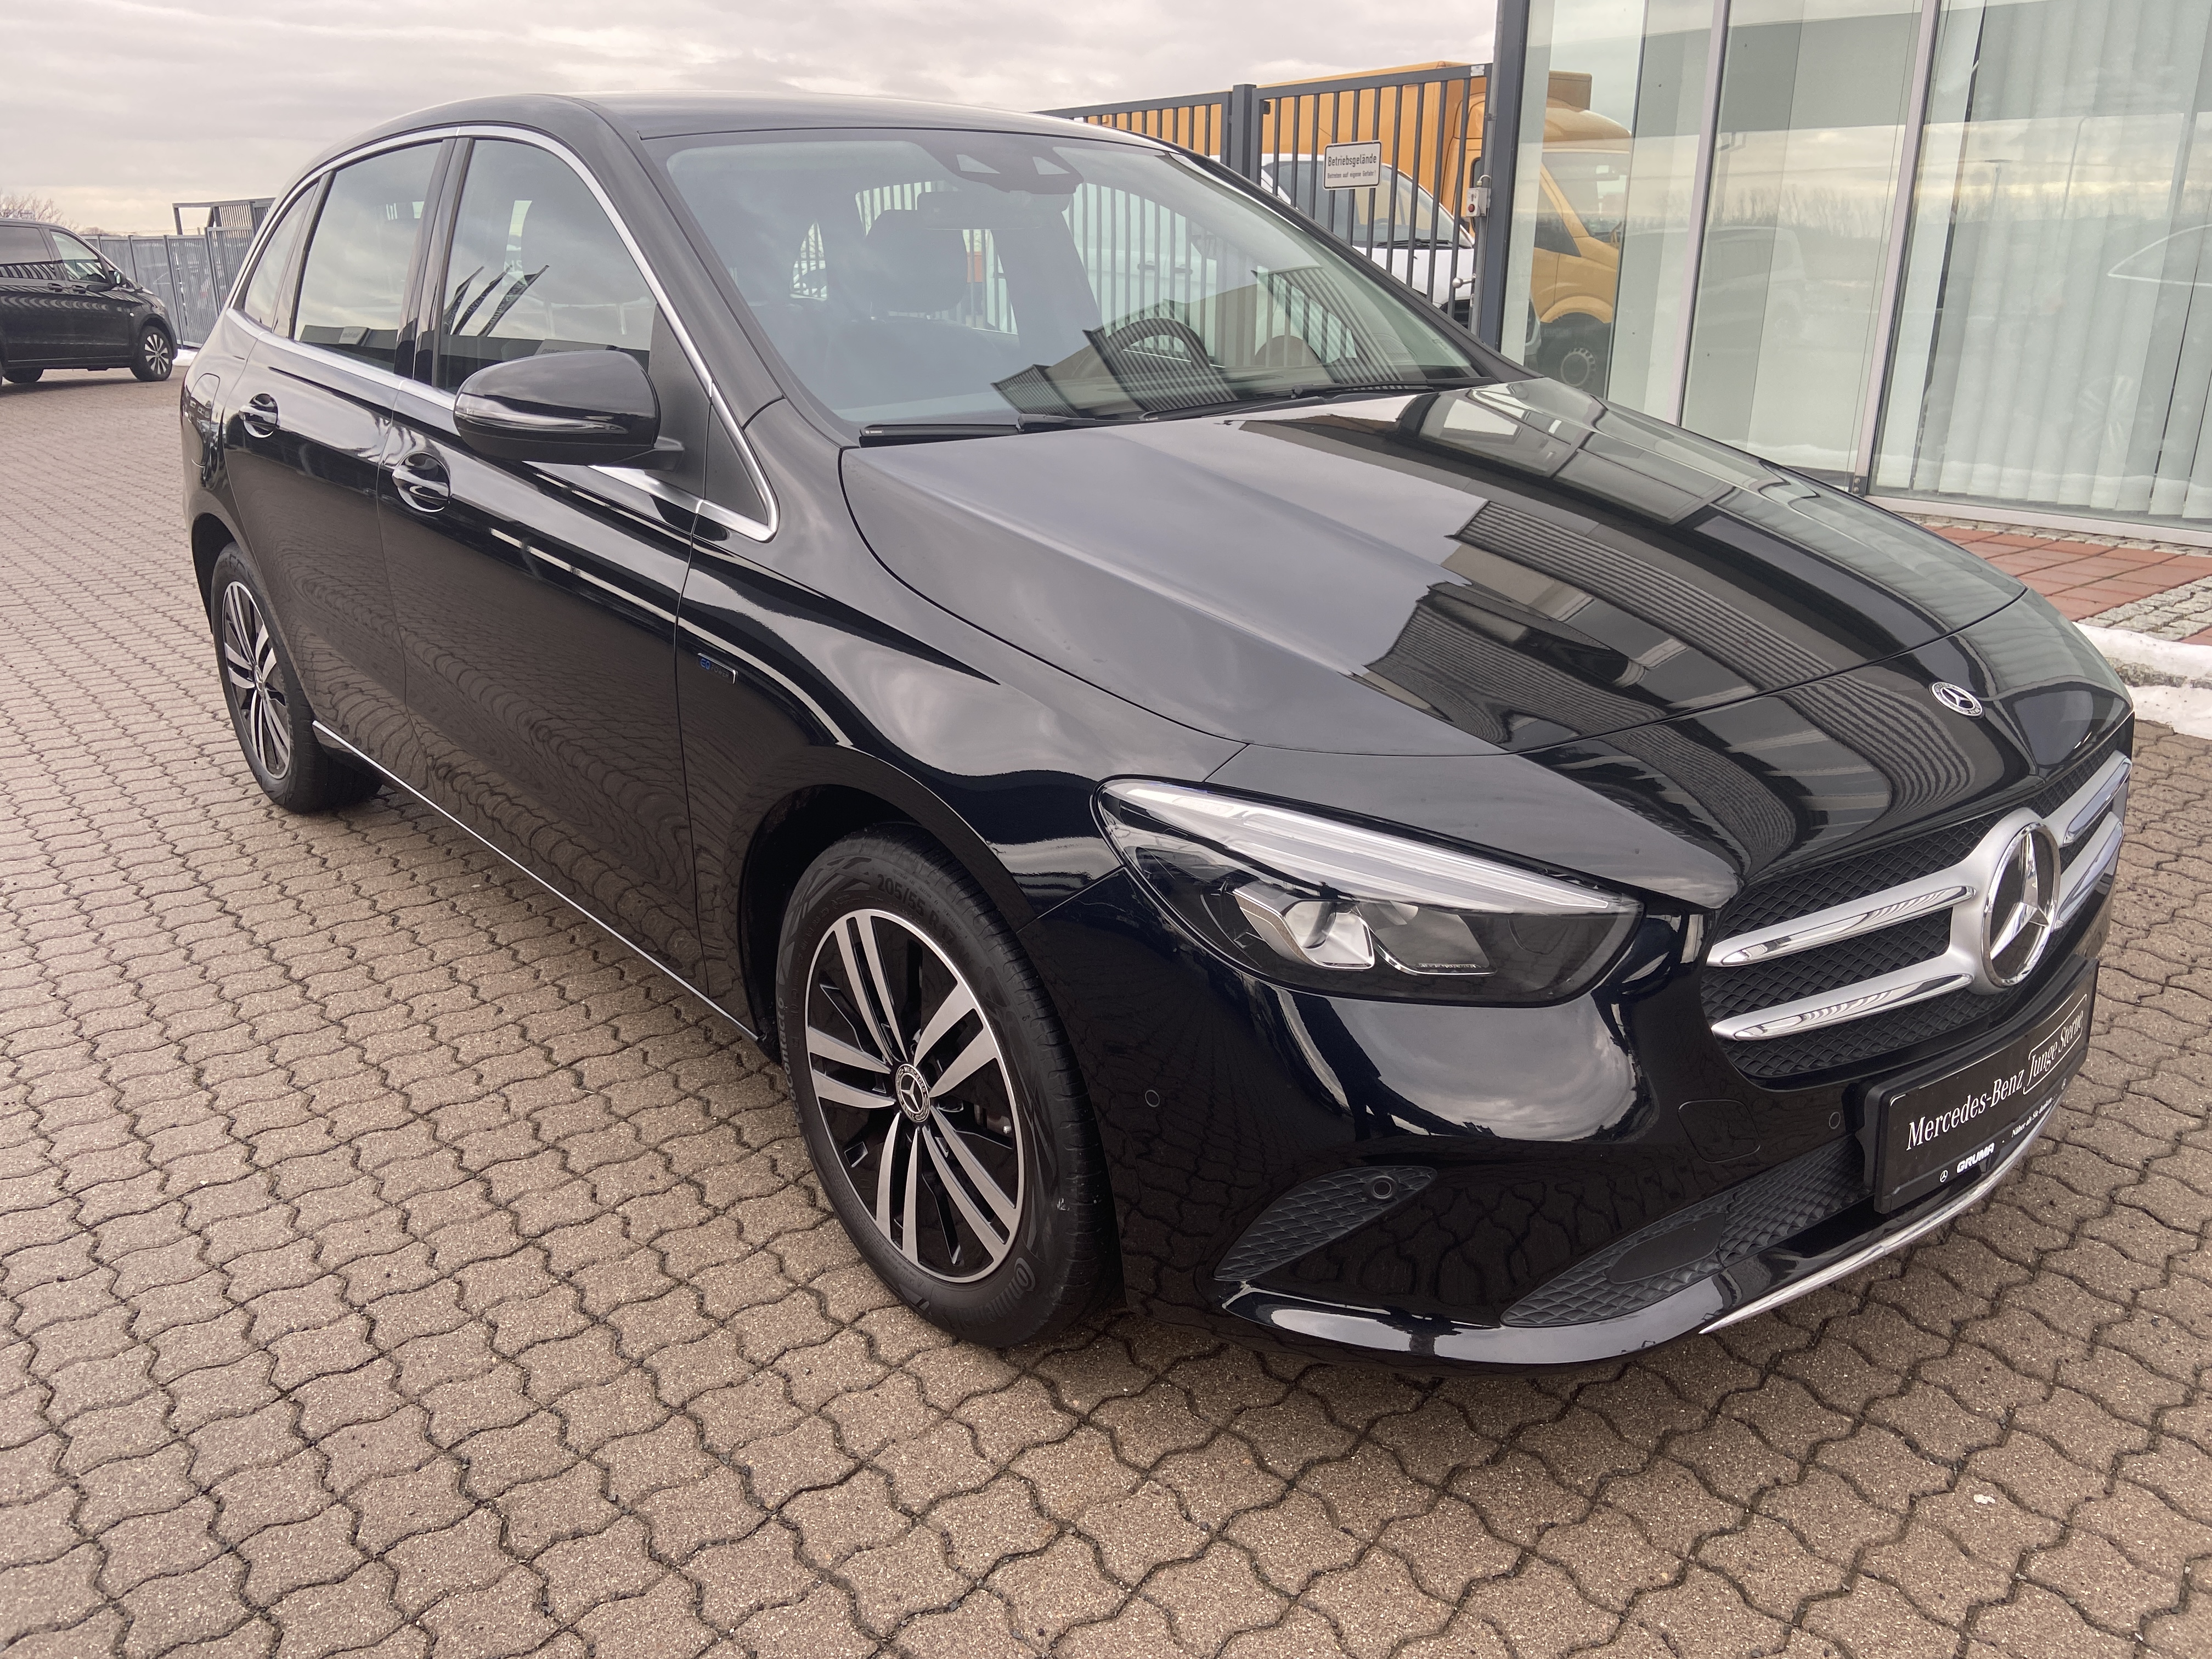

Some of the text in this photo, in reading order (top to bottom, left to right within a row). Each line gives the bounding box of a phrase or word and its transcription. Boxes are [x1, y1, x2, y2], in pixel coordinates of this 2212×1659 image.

[1328, 153, 1377, 167] Betriebsgelände
[701, 658, 729, 678] EQ POWER
[877, 873, 926, 917] 205/55
[928, 910, 940, 931] R
[941, 924, 956, 946] 17
[777, 996, 804, 1124] EcoContact 6
[904, 1066, 927, 1093] MERCEDES
[1906, 1010, 2084, 1151] Mercedes-Benz Junge Sterne
[1956, 1142, 1995, 1173] GRUMA
